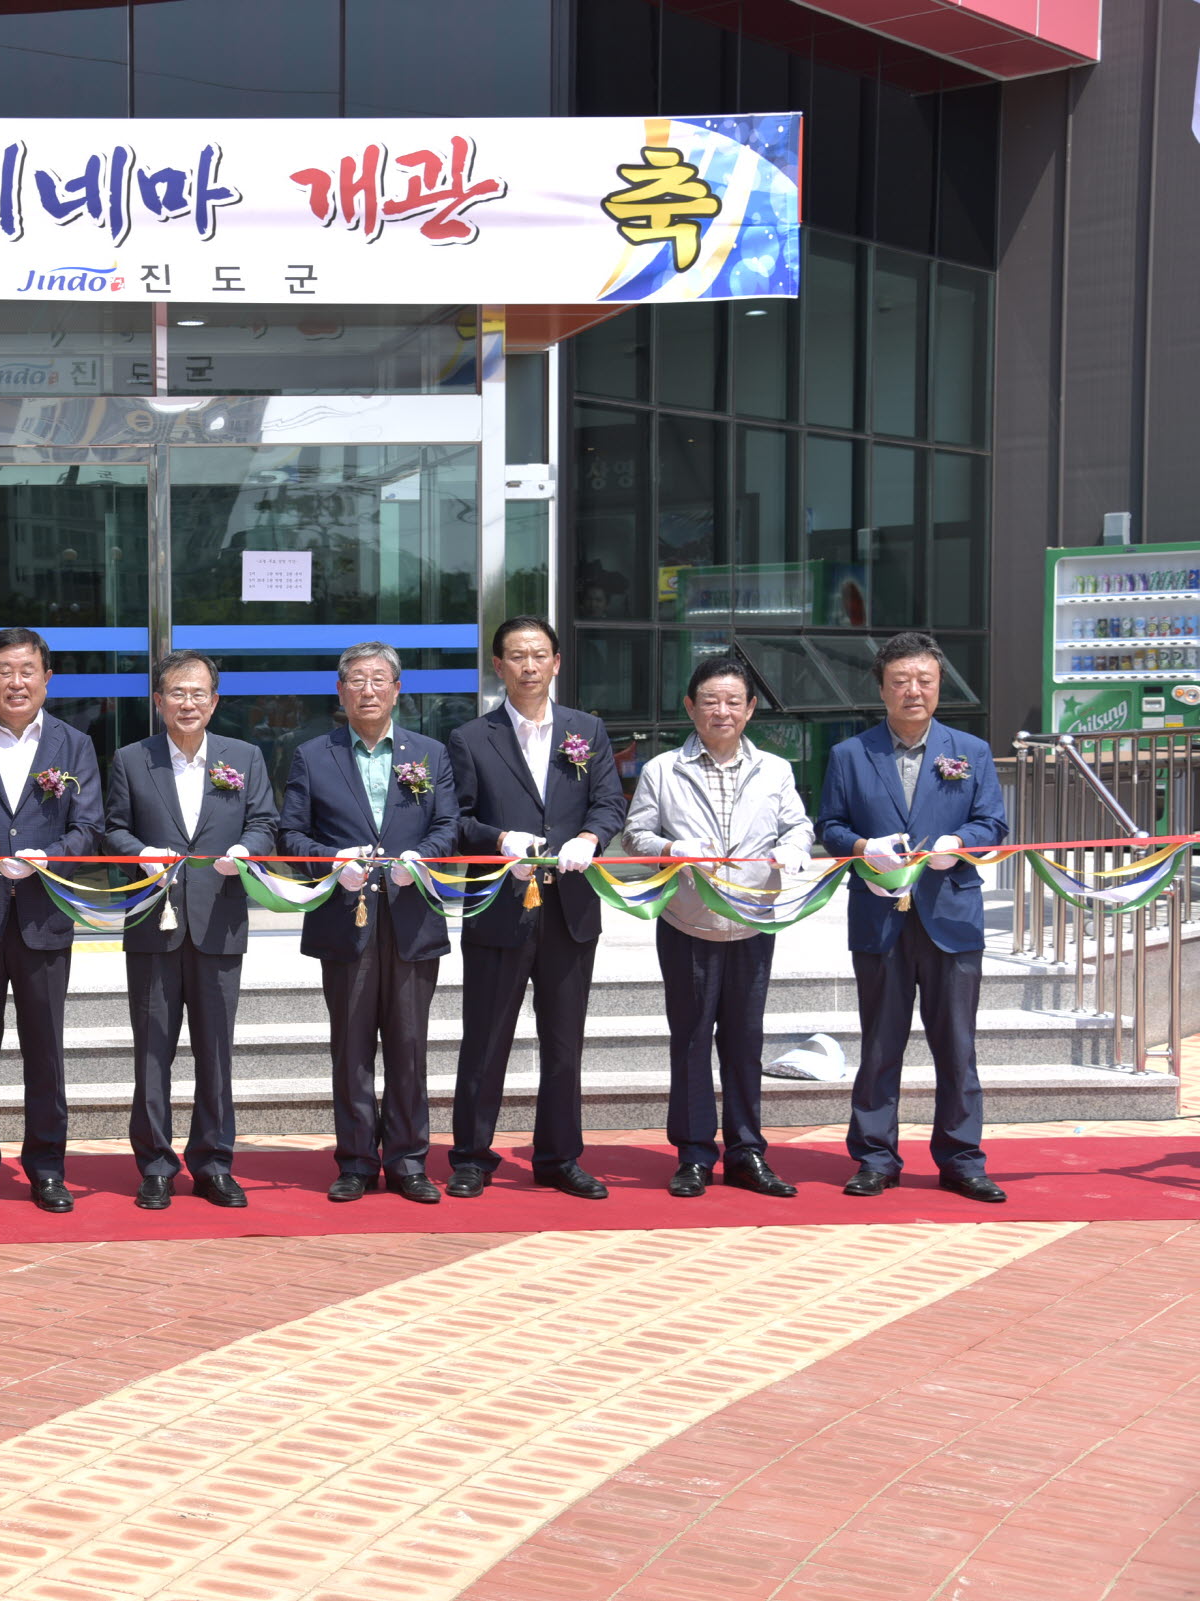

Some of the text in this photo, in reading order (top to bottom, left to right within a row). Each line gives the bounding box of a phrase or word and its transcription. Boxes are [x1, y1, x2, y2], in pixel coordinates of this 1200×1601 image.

[289, 135, 509, 247] 개관
[600, 146, 722, 271] 축
[16, 268, 107, 292] Jindo
